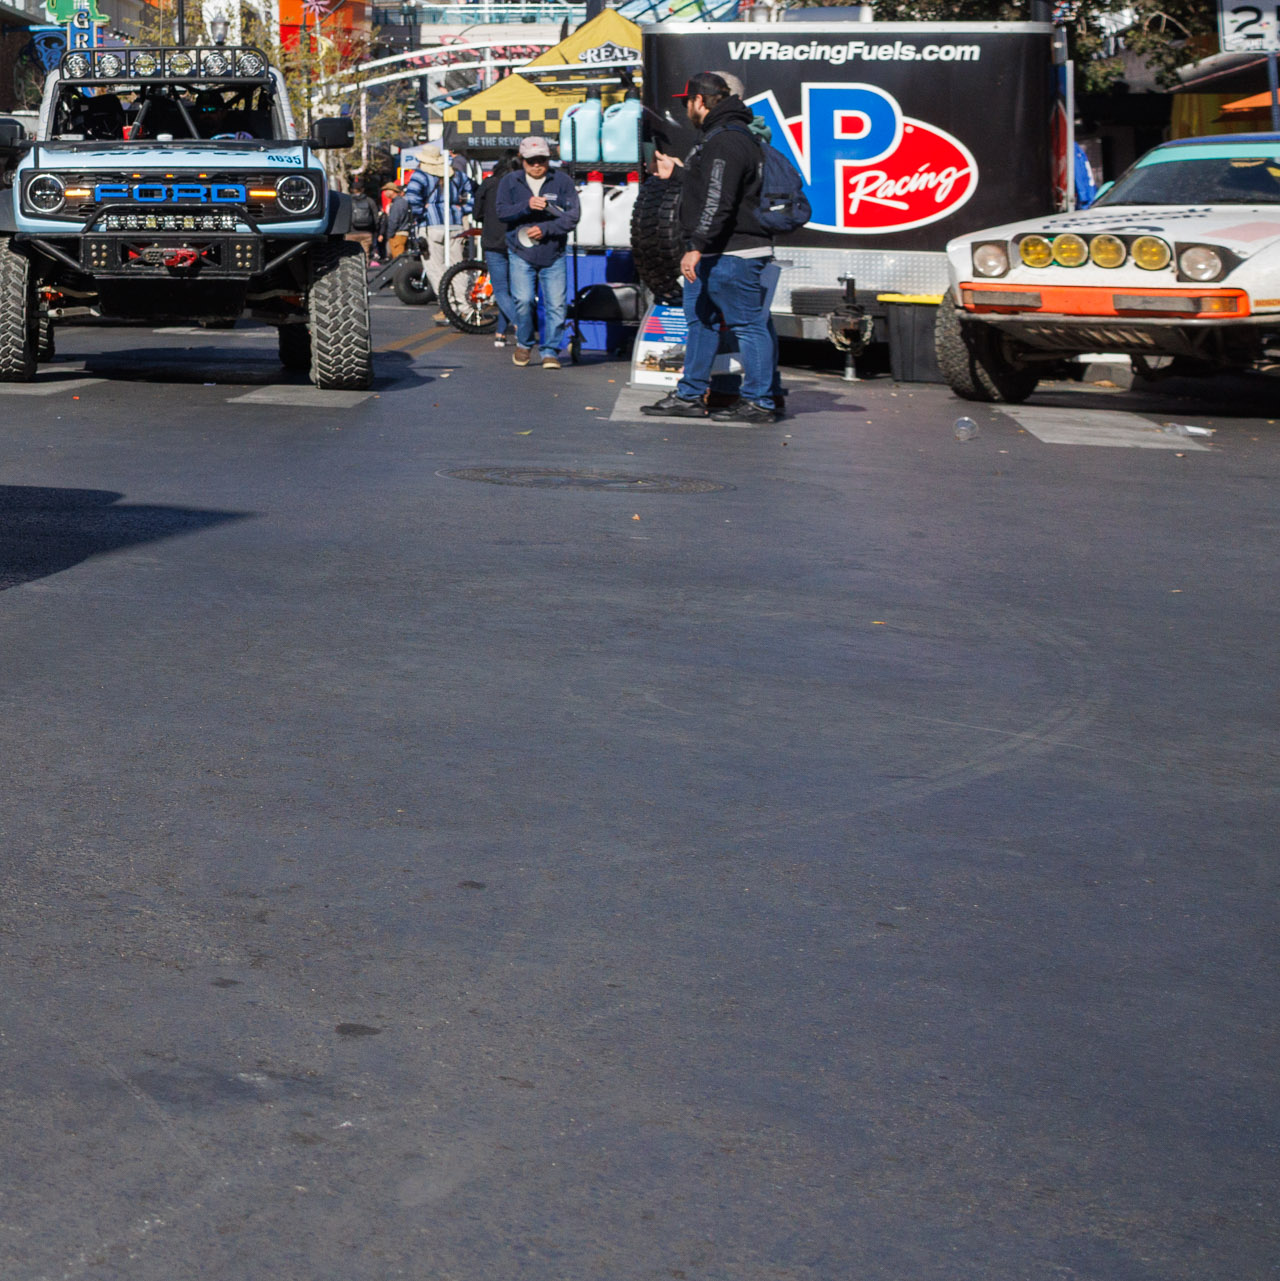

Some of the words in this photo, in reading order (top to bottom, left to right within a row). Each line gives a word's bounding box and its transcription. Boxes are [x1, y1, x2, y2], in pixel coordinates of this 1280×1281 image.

[728, 41, 980, 65] VPRacingFuels.com
[468, 137, 480, 146] BE
[482, 137, 496, 146] THE
[267, 154, 302, 165] 4635
[95, 184, 246, 203] FORD
[848, 163, 975, 215] Racing
